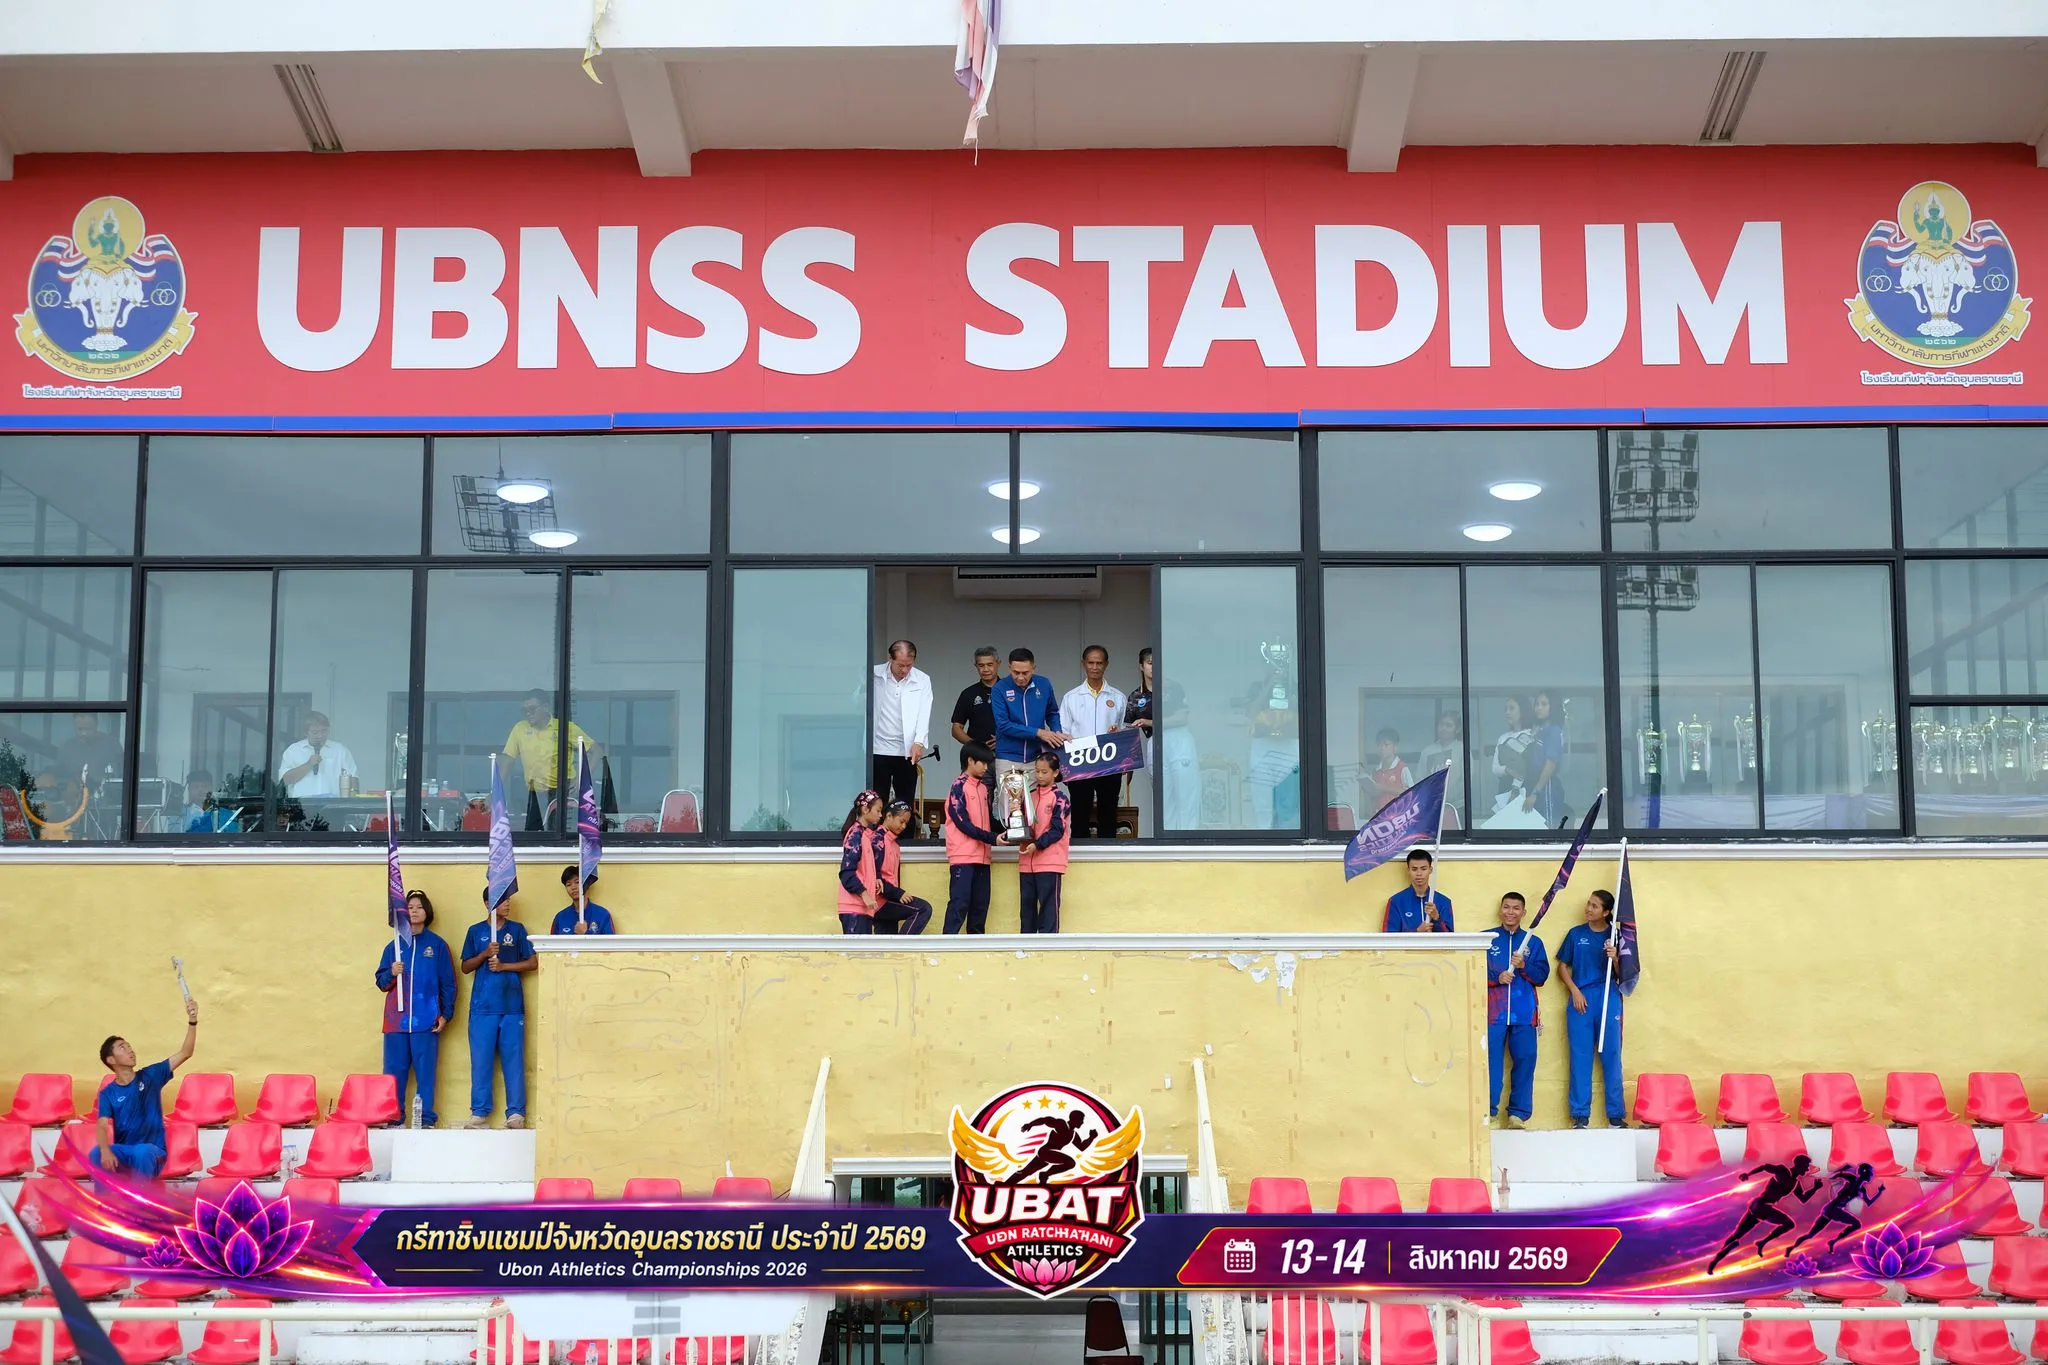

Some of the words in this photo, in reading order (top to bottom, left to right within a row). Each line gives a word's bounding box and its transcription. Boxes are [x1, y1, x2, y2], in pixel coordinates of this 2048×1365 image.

[257, 226, 861, 374] UBNSS
[965, 222, 1788, 370] STADIUM
[1069, 743, 1117, 767] 800
